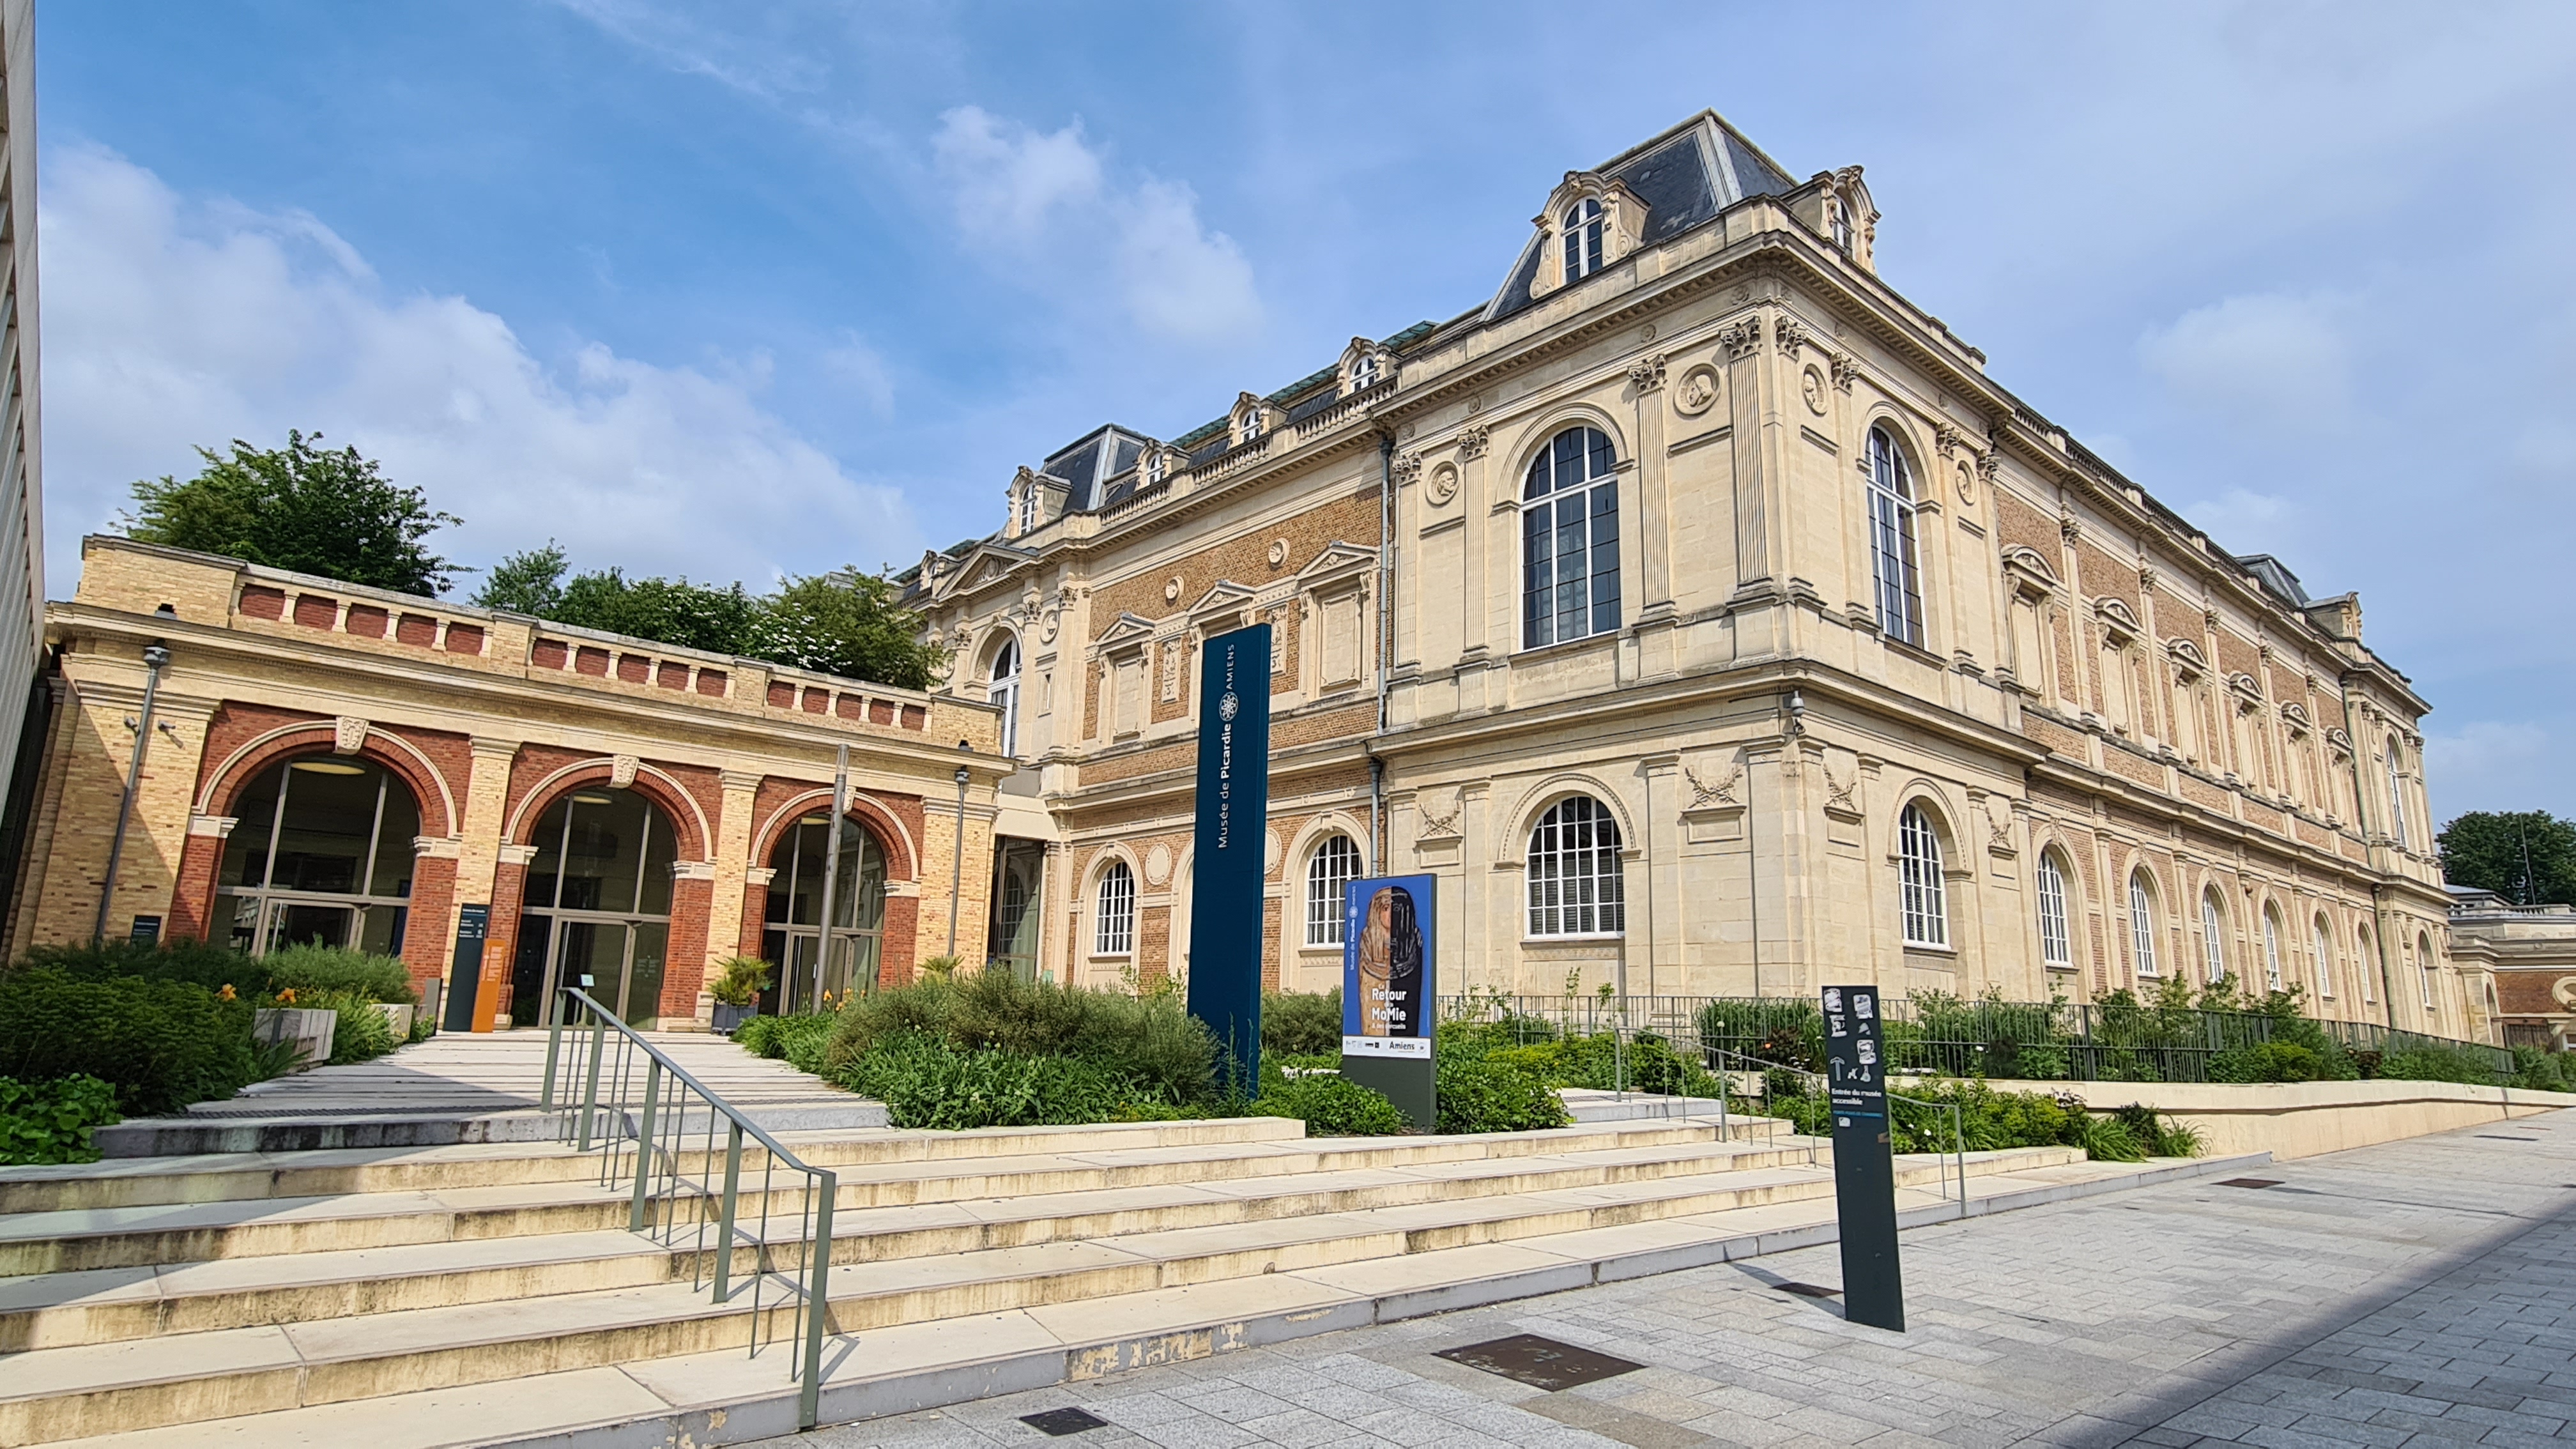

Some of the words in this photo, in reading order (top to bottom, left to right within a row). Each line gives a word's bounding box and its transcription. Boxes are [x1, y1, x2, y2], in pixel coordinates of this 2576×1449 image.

[1226, 644, 1234, 690] AMIENS
[1221, 723, 1231, 779] Picardie
[1220, 783, 1229, 799] de
[1218, 803, 1229, 849] Musée
[1372, 988, 1407, 1001] Retour
[1372, 1008, 1406, 1020] MoMie
[1390, 1041, 1414, 1050] Amiens
